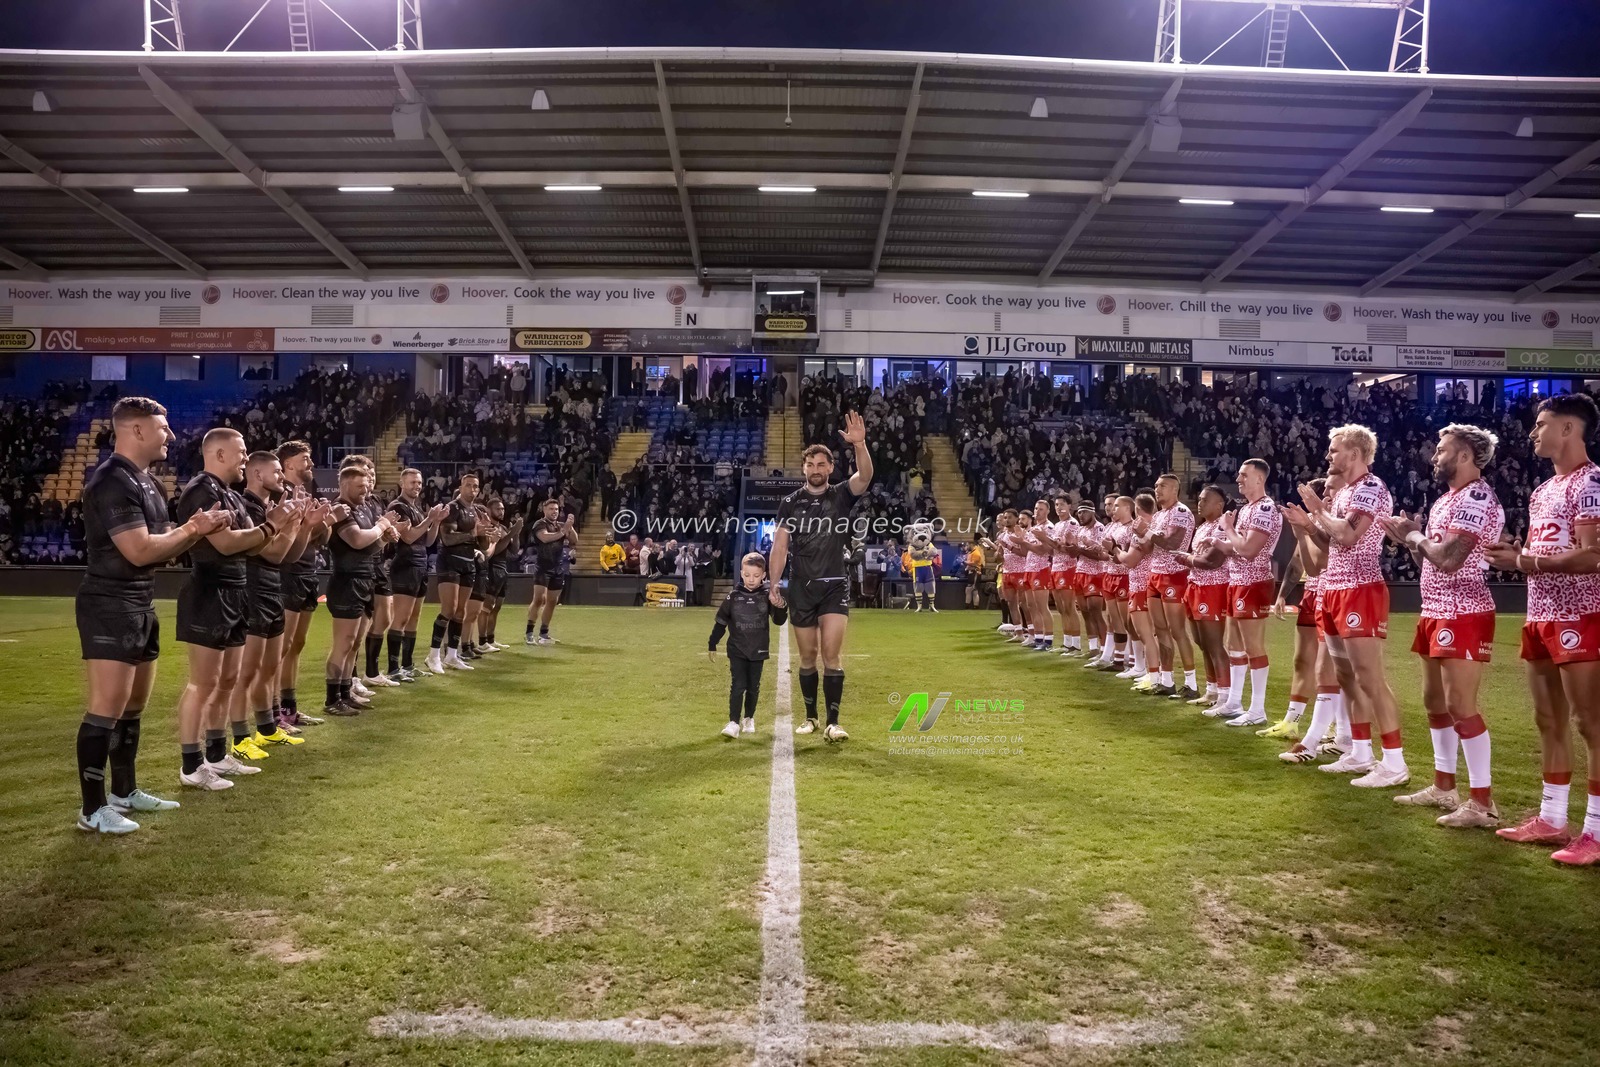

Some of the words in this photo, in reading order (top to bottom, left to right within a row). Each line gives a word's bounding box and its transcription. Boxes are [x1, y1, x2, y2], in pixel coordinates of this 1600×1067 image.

[8, 288, 52, 300] Hoover.
[58, 288, 88, 300] Wash
[93, 288, 112, 300] the
[117, 290, 140, 302] way
[144, 290, 166, 302] you
[170, 288, 192, 300] live
[232, 288, 277, 300] Hoover.
[282, 288, 314, 298] Clean
[318, 288, 338, 298] the
[342, 290, 366, 300] way
[371, 290, 393, 300] you
[398, 287, 420, 298] live
[462, 286, 508, 298] Hoover.
[514, 287, 544, 298] Cook
[550, 288, 571, 298] the
[576, 290, 601, 301] way
[606, 290, 628, 301] you
[633, 288, 655, 300] live
[893, 293, 940, 304] Hoover.
[946, 294, 977, 306] Cook
[982, 294, 1003, 306] the
[1008, 298, 1032, 309] way
[1037, 298, 1060, 310] you
[1065, 297, 1086, 308] live
[1128, 299, 1174, 312] Hoover.
[1180, 301, 1206, 312] Chill
[1211, 302, 1231, 313] the
[1238, 304, 1262, 316] way
[1266, 305, 1288, 316] you
[1292, 304, 1314, 316] live
[686, 314, 696, 326] N
[1354, 306, 1397, 318] Hoover.
[1402, 308, 1431, 320] Wash
[1436, 310, 1454, 320] the
[1456, 312, 1479, 324] way
[1484, 313, 1504, 324] you
[1511, 312, 1532, 322] live
[45, 330, 84, 350] ASL
[84, 336, 116, 345] making
[392, 340, 444, 349] Wienerberger
[986, 337, 1012, 356] JLJ
[1013, 337, 1066, 356] Group
[1092, 340, 1145, 353] MAXILEAD
[1150, 342, 1190, 354] METALS
[1229, 345, 1274, 356] Nimbus
[1331, 346, 1373, 362] Total
[1520, 352, 1550, 364] one
